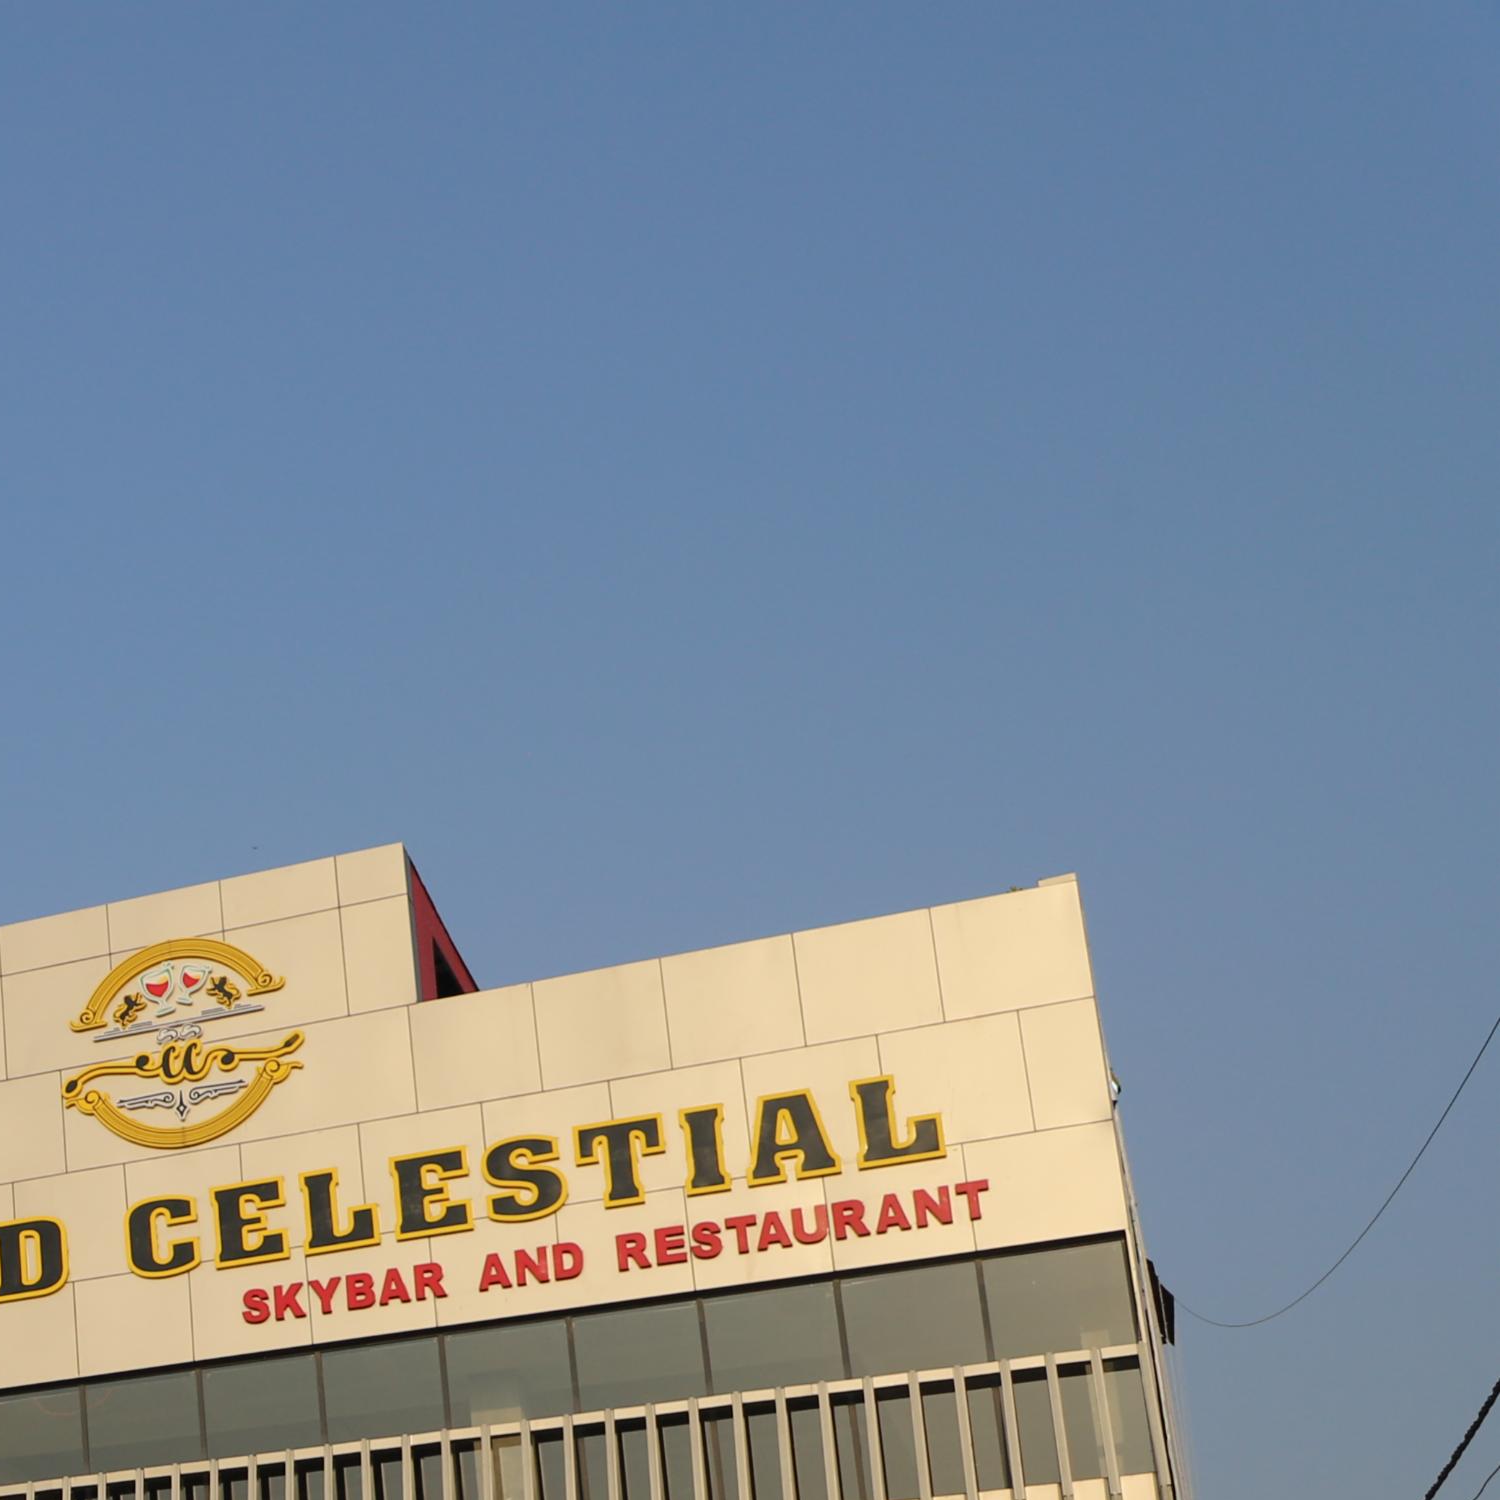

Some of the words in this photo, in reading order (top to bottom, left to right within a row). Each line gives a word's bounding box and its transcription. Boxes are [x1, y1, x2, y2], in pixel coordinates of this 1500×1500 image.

[125, 1073, 947, 1280] CELESTIAL
[241, 1261, 447, 1325] SKYBAR
[479, 1242, 586, 1295] AND
[615, 1179, 990, 1271] RESTAURANT
